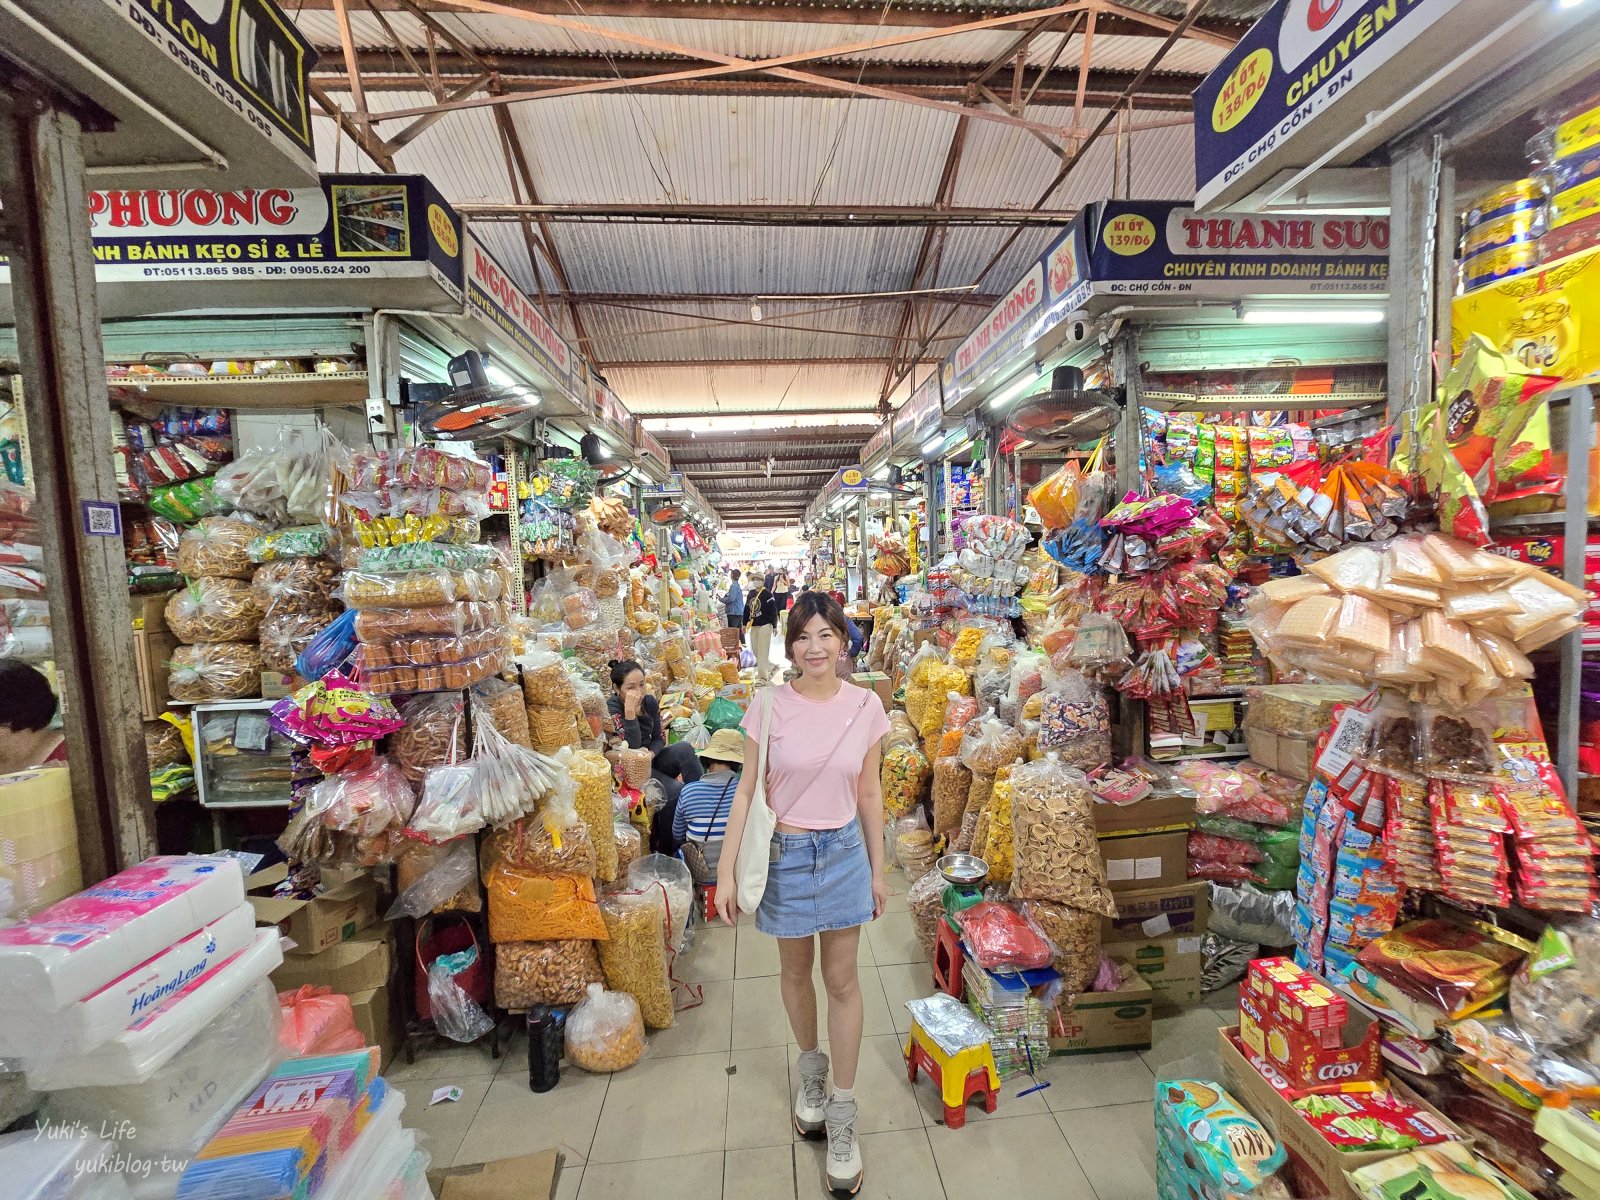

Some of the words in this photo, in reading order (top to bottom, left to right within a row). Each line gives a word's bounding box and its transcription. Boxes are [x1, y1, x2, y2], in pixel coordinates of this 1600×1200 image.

[1286, 0, 1398, 107] CHUYÊN
[167, 41, 244, 113] 0986.034
[247, 109, 273, 137] 095
[1221, 83, 1237, 104] KI
[1239, 57, 1260, 88] ỐT
[1217, 71, 1267, 127] 138/Đ6
[1223, 159, 1245, 184] ĐC:
[1248, 133, 1277, 165] CHỢ
[1327, 68, 1353, 99] ĐN
[1113, 221, 1125, 232] KI
[1128, 218, 1144, 232] ỐT
[1182, 218, 1315, 249] THANH
[127, 241, 189, 260] BÁNH
[195, 243, 242, 263] KẸO
[247, 238, 269, 259] SỈ
[274, 243, 291, 258] &
[297, 237, 324, 258] LẺ
[1109, 235, 1151, 246] 139/Đ6
[143, 267, 229, 277] ĐT:05113.865
[232, 266, 255, 275] 985
[289, 265, 345, 275] 0905.624
[348, 265, 371, 274] 200
[473, 246, 520, 317] NGỌC
[1163, 260, 1227, 277] CHUYÊN
[1230, 263, 1267, 276] KINH
[1270, 262, 1321, 276] DOANH
[1324, 260, 1366, 277] BÁNH
[1110, 283, 1127, 292] ĐC:
[1129, 282, 1149, 294] CHỢ
[1178, 283, 1192, 291] ĐN
[1370, 283, 1386, 291] 542
[957, 324, 991, 371] THANH
[1240, 997, 1263, 1023] COSY
[1317, 1061, 1362, 1081] COSY
